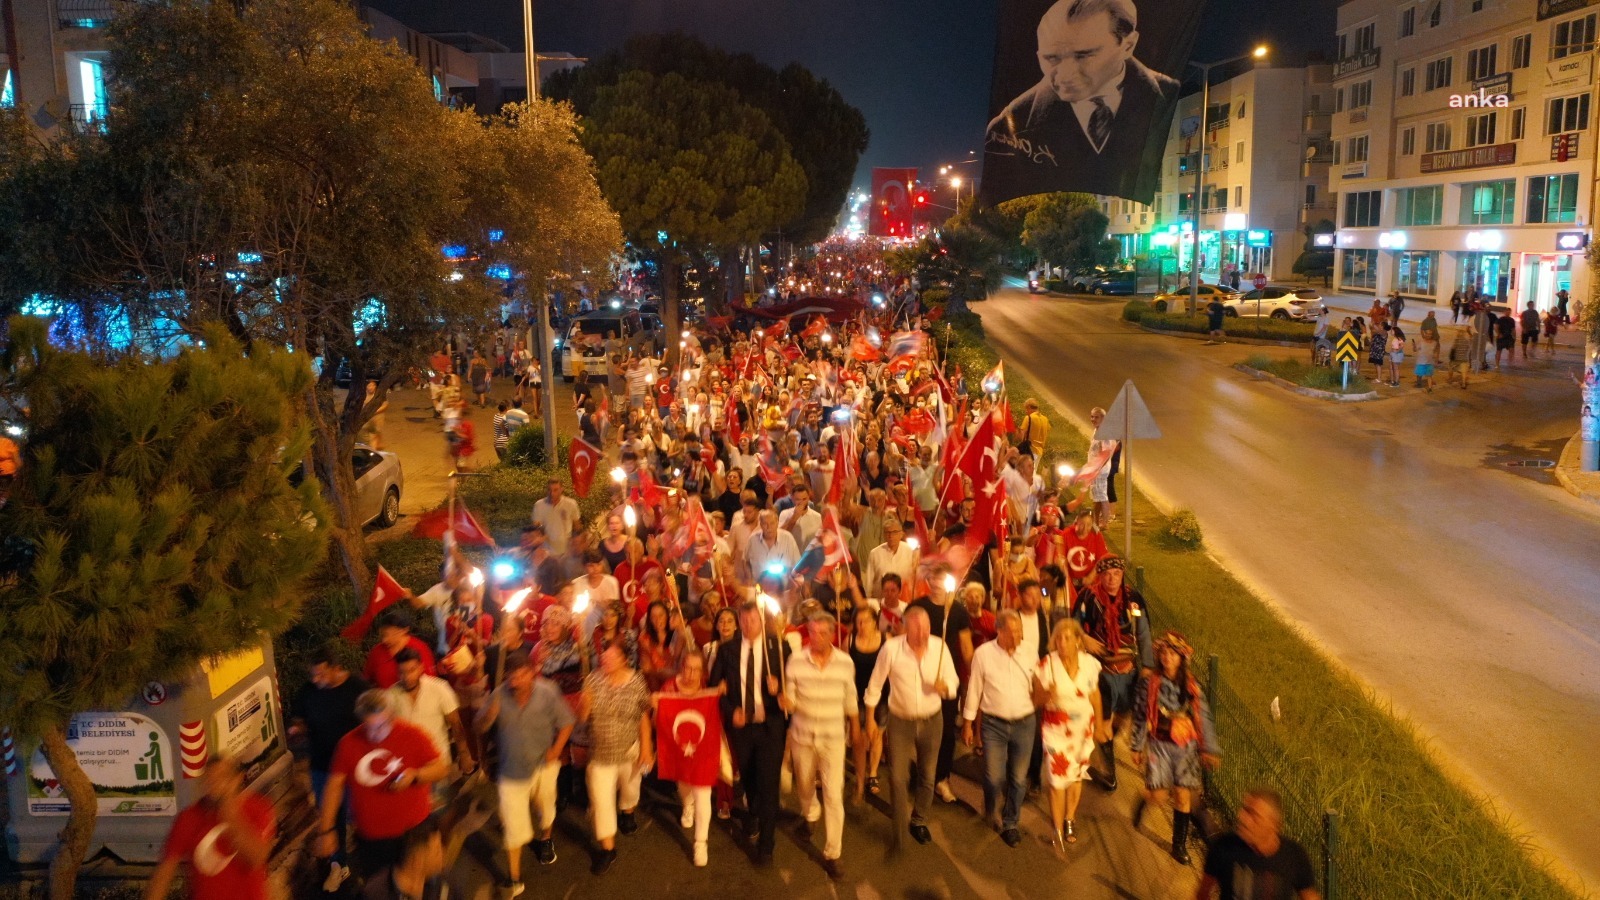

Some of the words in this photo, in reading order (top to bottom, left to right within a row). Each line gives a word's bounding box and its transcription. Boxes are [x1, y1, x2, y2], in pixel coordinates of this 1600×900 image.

[1340, 56, 1362, 74] Emlak
[1363, 53, 1378, 67] Tur
[81, 720, 95, 728] T.C.
[98, 718, 126, 728] DİDİM
[81, 728, 136, 738] BELEDİYESİ
[97, 748, 106, 756] bir
